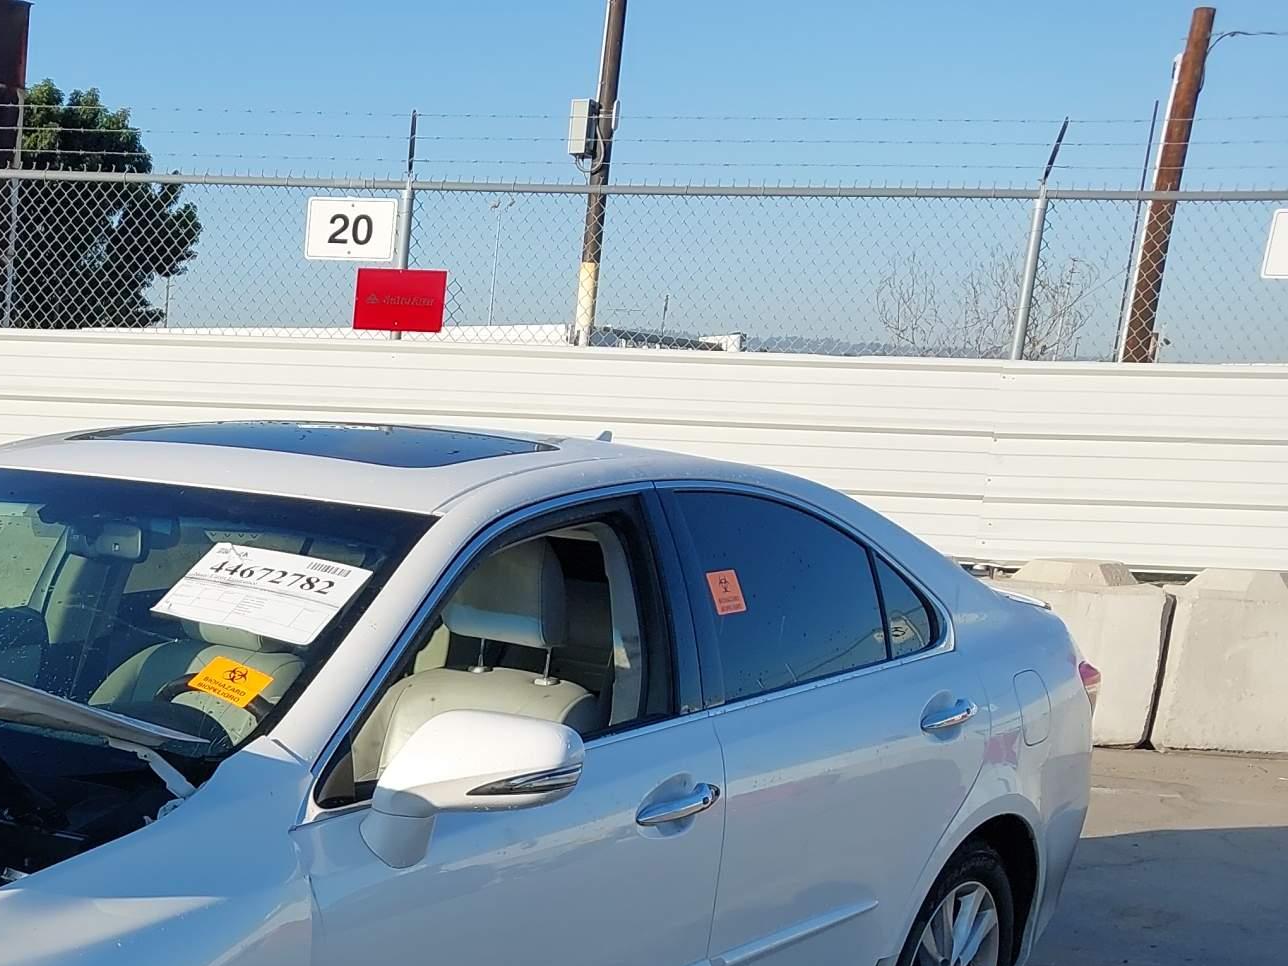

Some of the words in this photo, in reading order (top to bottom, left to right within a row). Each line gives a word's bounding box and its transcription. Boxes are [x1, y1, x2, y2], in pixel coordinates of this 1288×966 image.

[327, 213, 374, 246] 20
[209, 560, 335, 595] 44672782
[203, 676, 247, 698] BIOHAZARD
